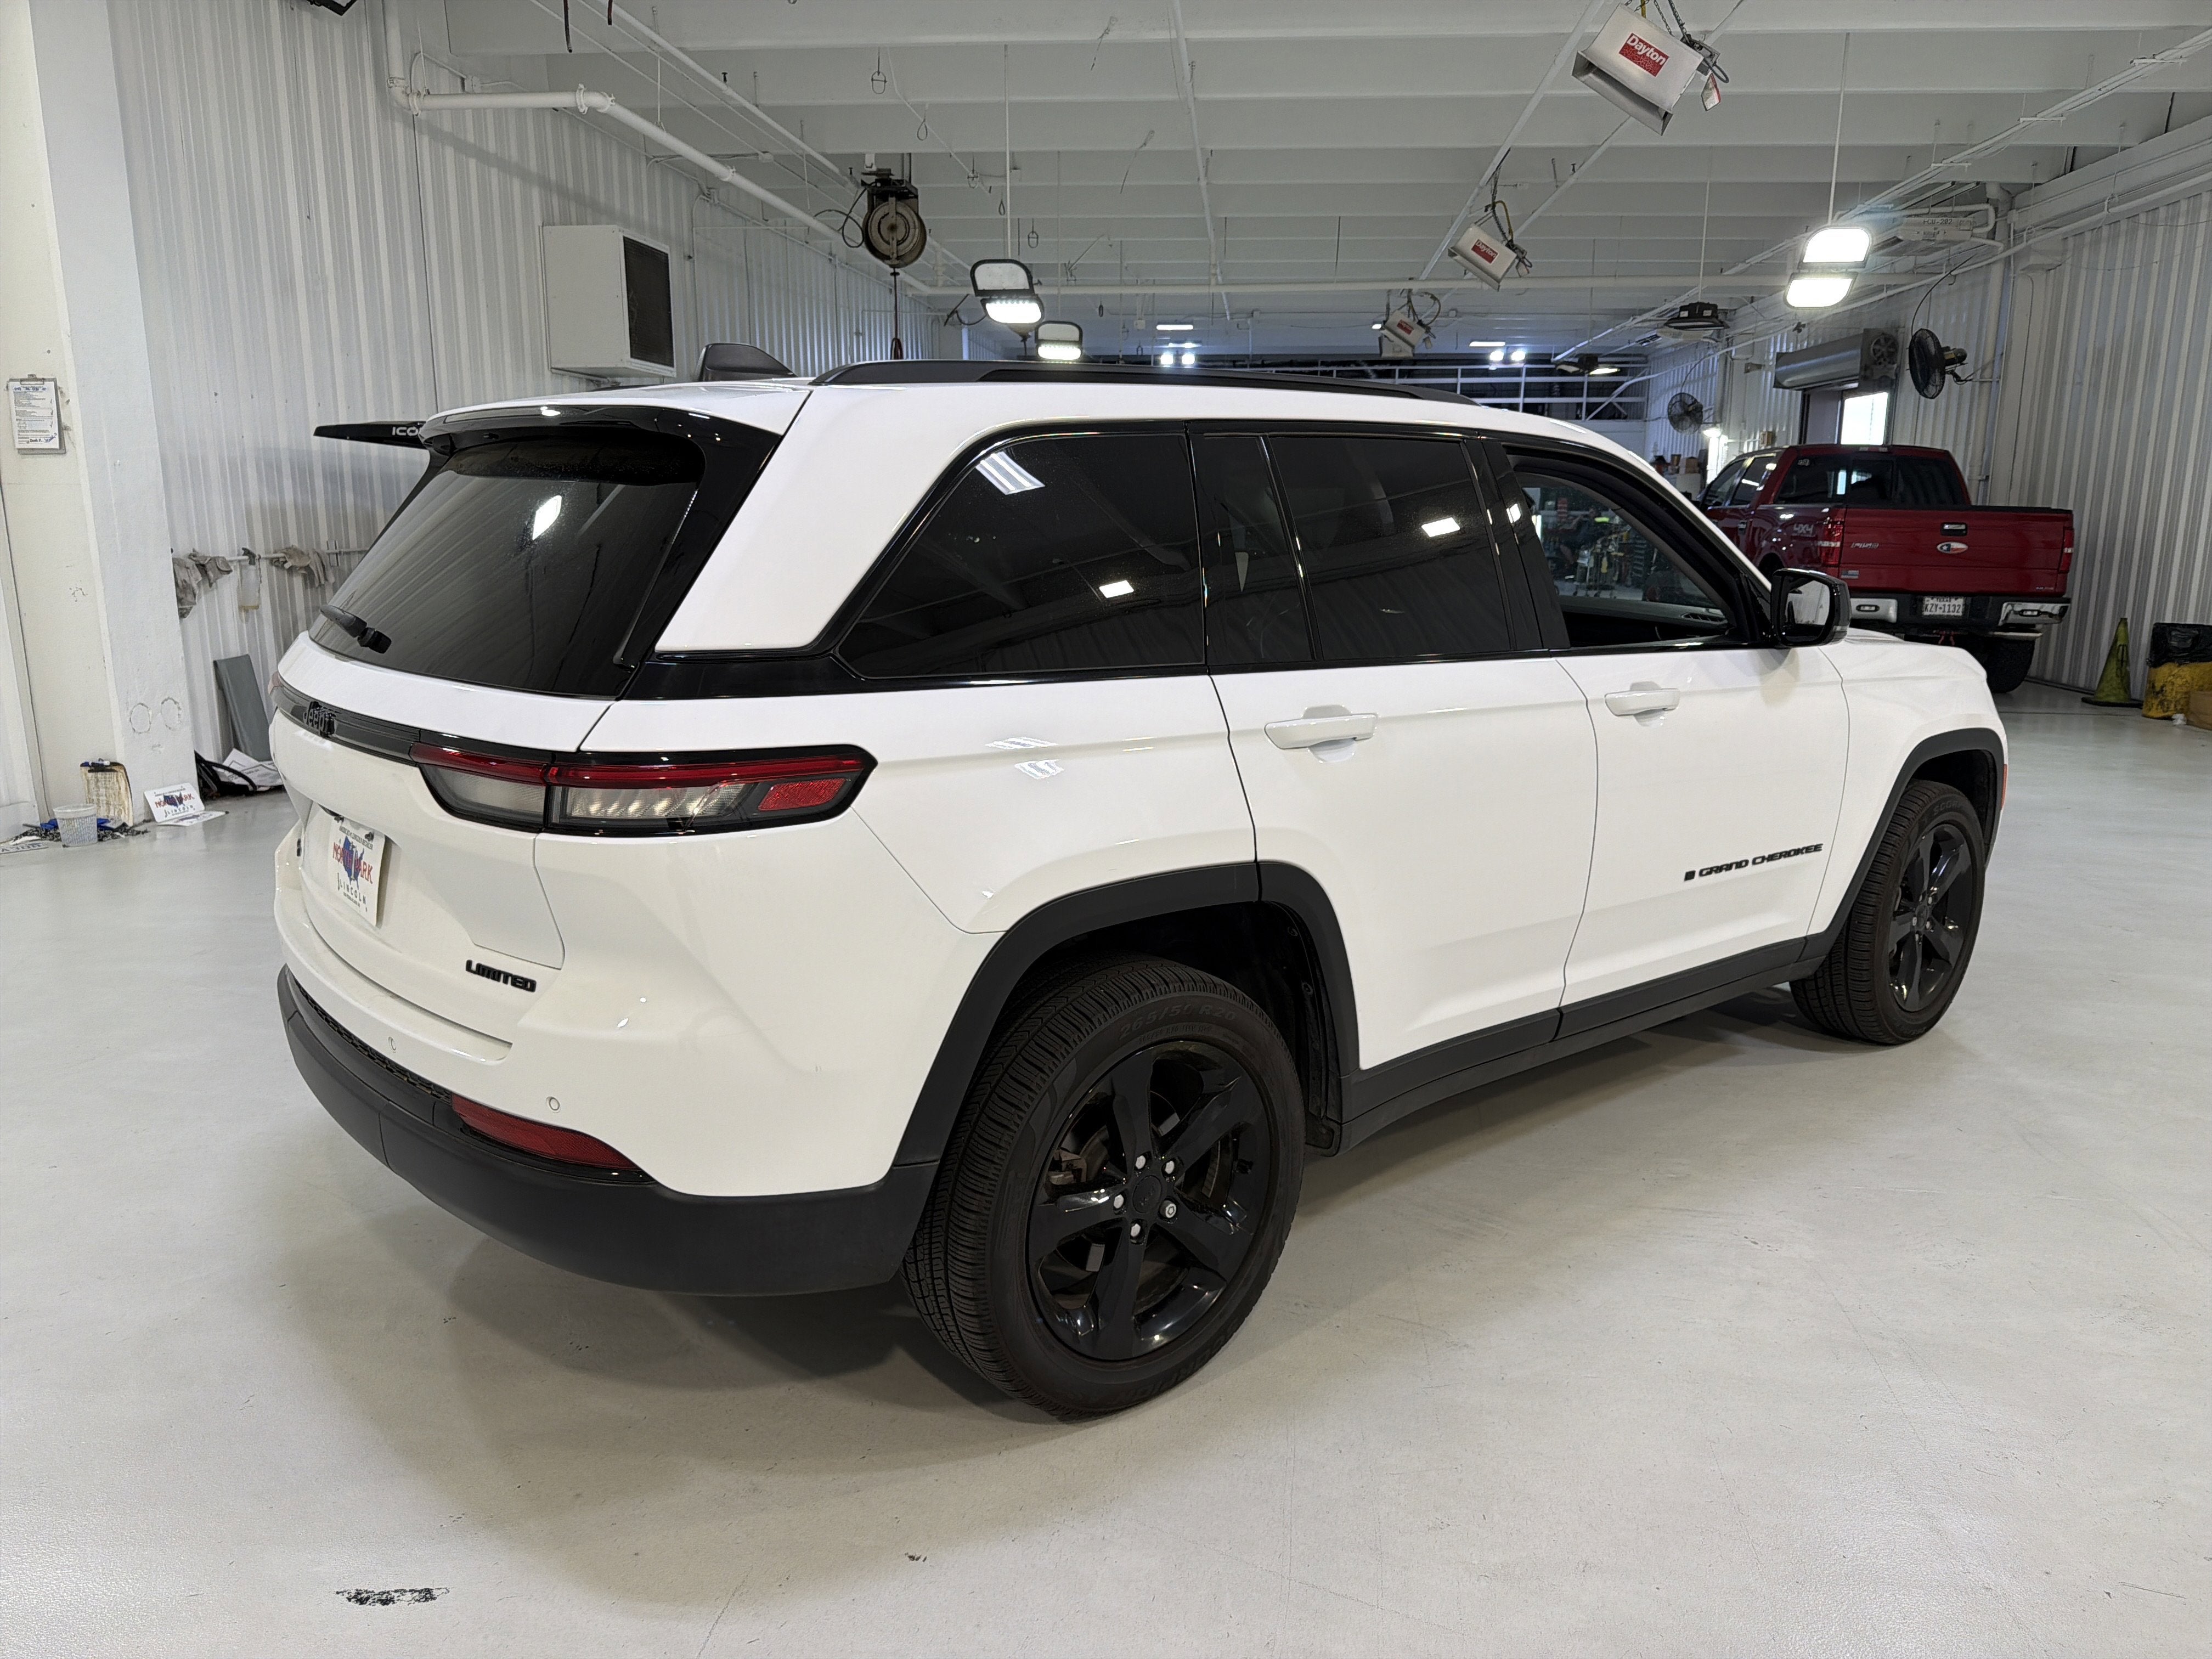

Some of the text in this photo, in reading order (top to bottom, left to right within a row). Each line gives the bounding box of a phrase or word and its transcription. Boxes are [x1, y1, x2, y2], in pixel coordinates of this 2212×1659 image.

[1626, 35, 1667, 66] Dayton
[1475, 241, 1497, 258] Dayton
[392, 426, 420, 436] ICO
[332, 842, 373, 884] NORTH PARK
[1699, 843, 1824, 877] GRAND CHEROKEE
[340, 880, 366, 905] LINCOLN
[465, 959, 537, 992] LIMITED
